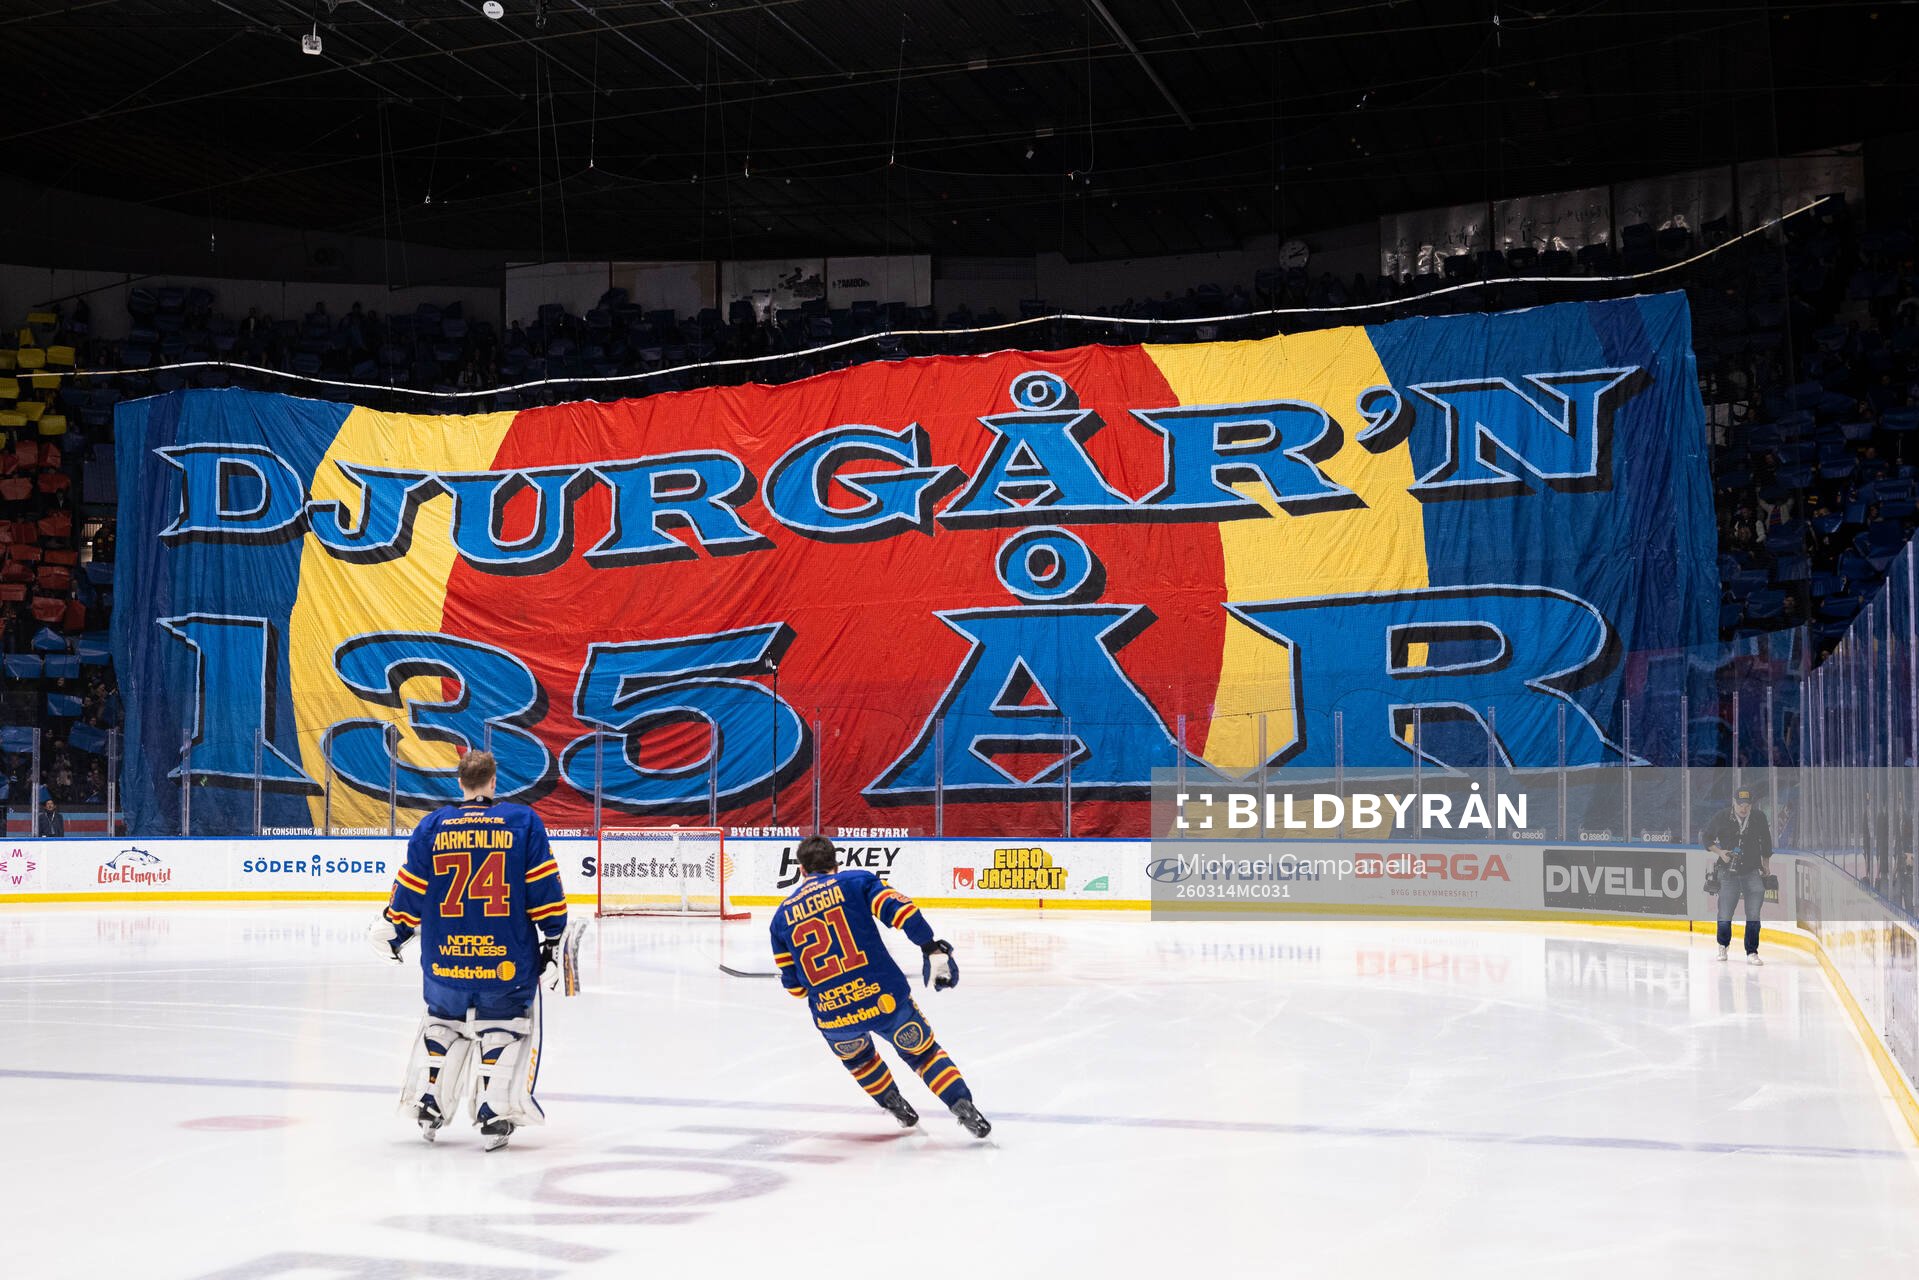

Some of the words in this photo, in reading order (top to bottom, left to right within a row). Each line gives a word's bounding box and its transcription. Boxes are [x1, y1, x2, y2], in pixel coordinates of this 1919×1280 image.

[157, 611, 813, 813] 135
[862, 525, 1655, 802] ÅR
[272, 828, 312, 836] CONSULTING
[313, 828, 323, 836] AB
[340, 827, 378, 836] CONSULTING
[379, 827, 388, 836] AB
[730, 826, 760, 837] BYGG
[762, 826, 800, 837] STARK
[837, 827, 868, 838] BYGG
[870, 827, 909, 838] STARK
[1521, 831, 1544, 840] asedo
[1588, 832, 1610, 841] asedo
[1650, 833, 1670, 843] asedo
[243, 857, 307, 873] SÖDER
[325, 857, 386, 874] SÖDER
[778, 847, 901, 877] HCKEY
[993, 847, 1044, 869] EURO
[97, 865, 119, 884] Lisa
[1354, 853, 1511, 882] BORGA
[432, 851, 511, 918] 74
[977, 867, 1064, 890] JACKPOT
[1545, 864, 1685, 899] DIVELLO
[1390, 888, 1410, 896] BYGG
[784, 885, 845, 926] LALEGGIA
[447, 934, 495, 946] NORDIC
[791, 905, 869, 986] 21
[438, 945, 507, 957] WELLNESS
[431, 962, 497, 979] Sundström
[816, 982, 881, 1012] WELLNESS
[818, 977, 866, 1002] NORDIC
